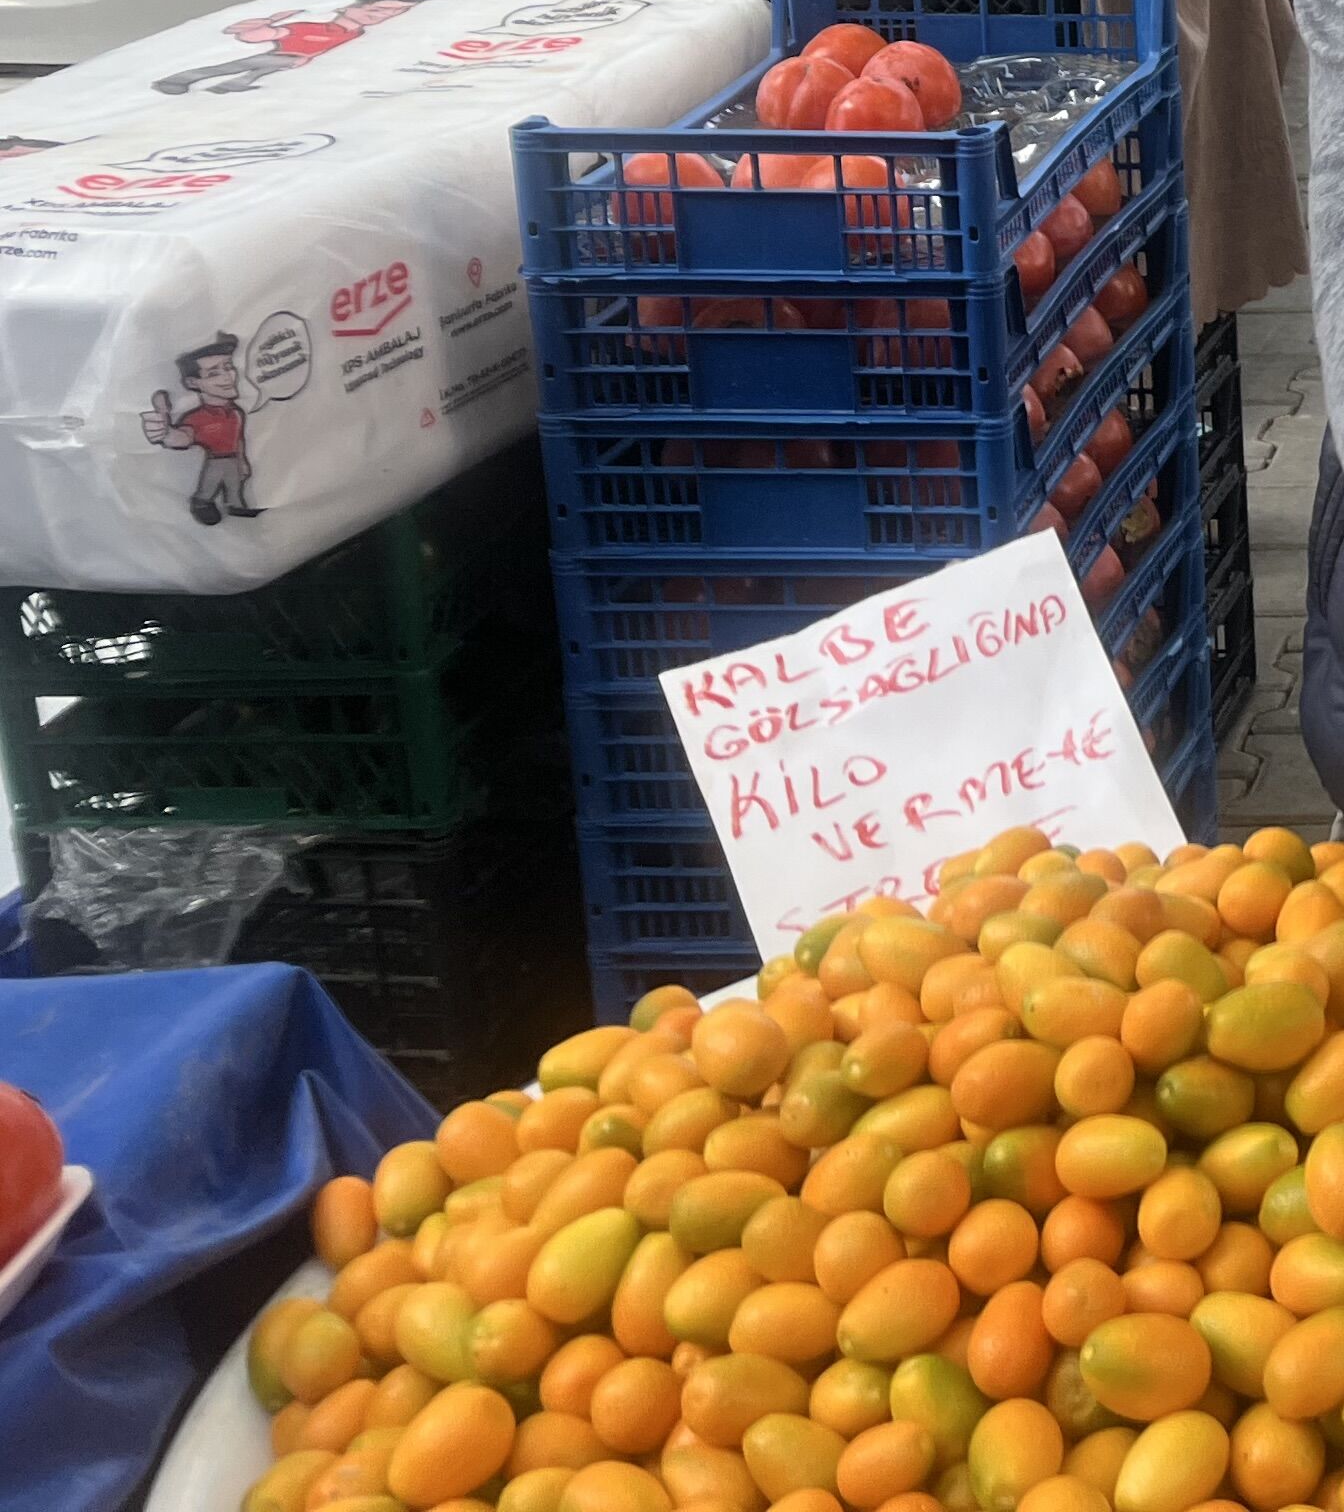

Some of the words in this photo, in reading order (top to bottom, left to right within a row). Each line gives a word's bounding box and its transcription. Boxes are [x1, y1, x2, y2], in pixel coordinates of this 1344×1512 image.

[331, 260, 409, 322] erze
[682, 597, 933, 718] KALBE
[728, 754, 888, 840] KİLO
